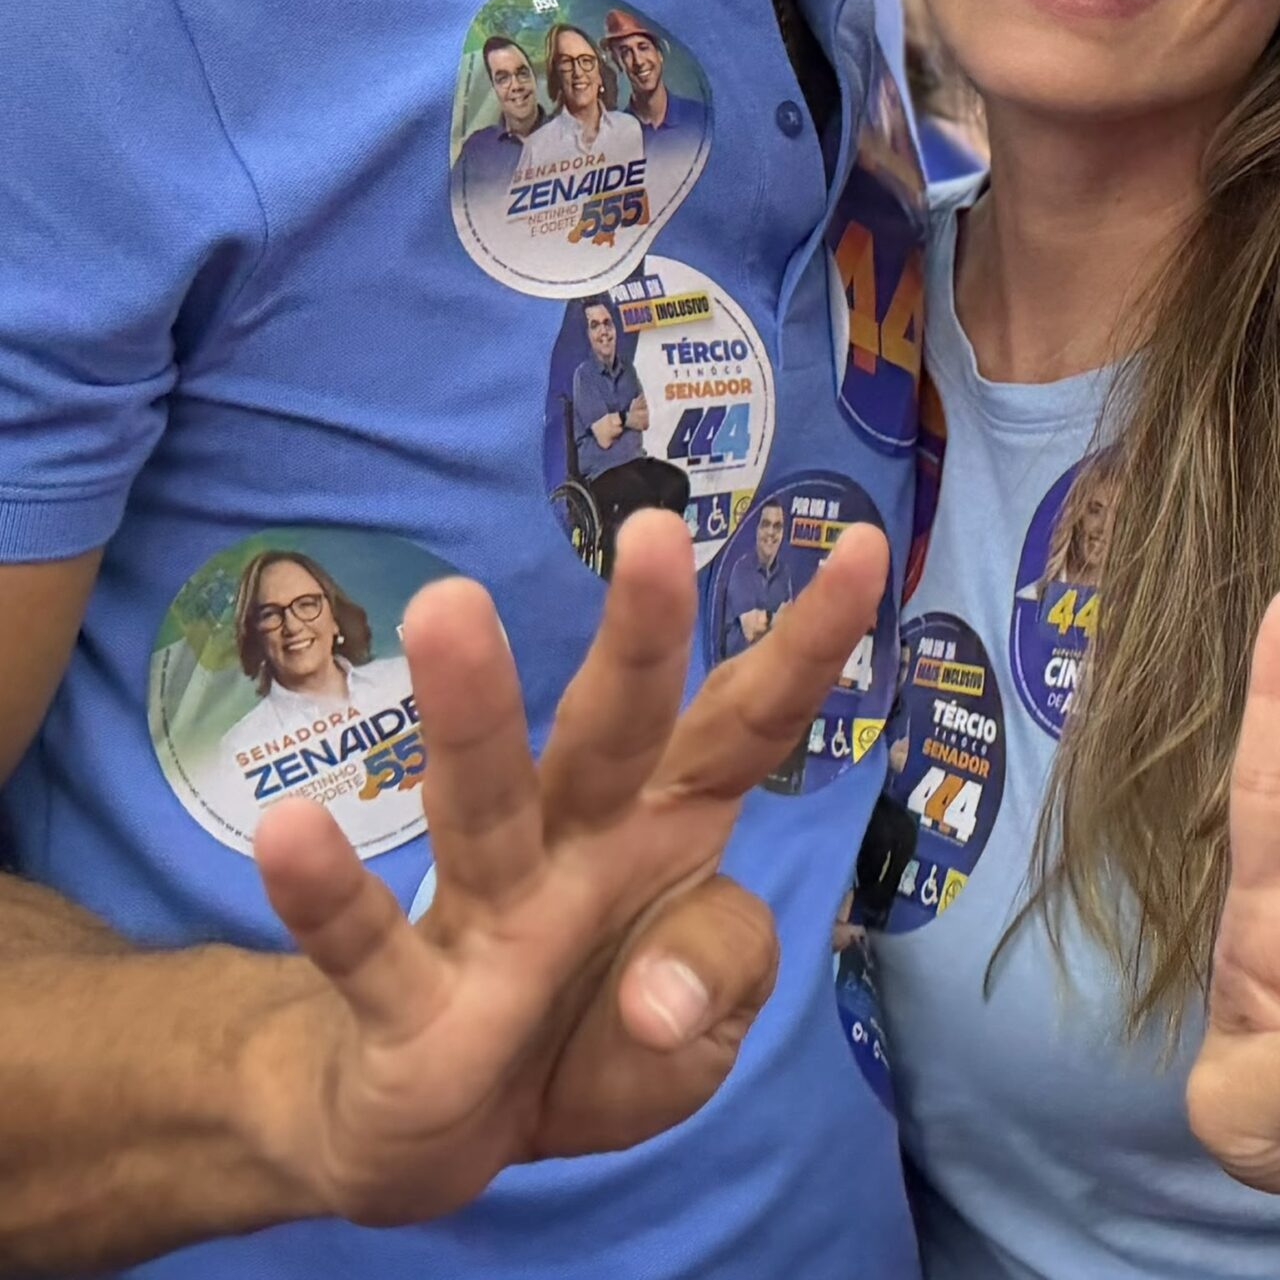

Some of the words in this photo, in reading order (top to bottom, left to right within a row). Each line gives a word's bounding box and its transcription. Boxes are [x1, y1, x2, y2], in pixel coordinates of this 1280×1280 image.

[507, 158, 647, 215] ZENAIDE
[513, 152, 606, 183] SENADORA
[528, 204, 578, 225] NETINHO
[580, 190, 645, 238] 555
[540, 218, 576, 235] ODETE
[655, 295, 709, 321] INCLUSIVO
[661, 336, 748, 366] TÉRCIO
[665, 377, 752, 401] SENADOR
[667, 402, 751, 466] 444
[941, 667, 983, 690] INCLUSIVO
[236, 707, 361, 767] SENADORA
[933, 699, 997, 744] TÉRCIO
[245, 695, 421, 800] ZENAIDE
[922, 737, 991, 779] SENADOR
[907, 766, 983, 842] 444
